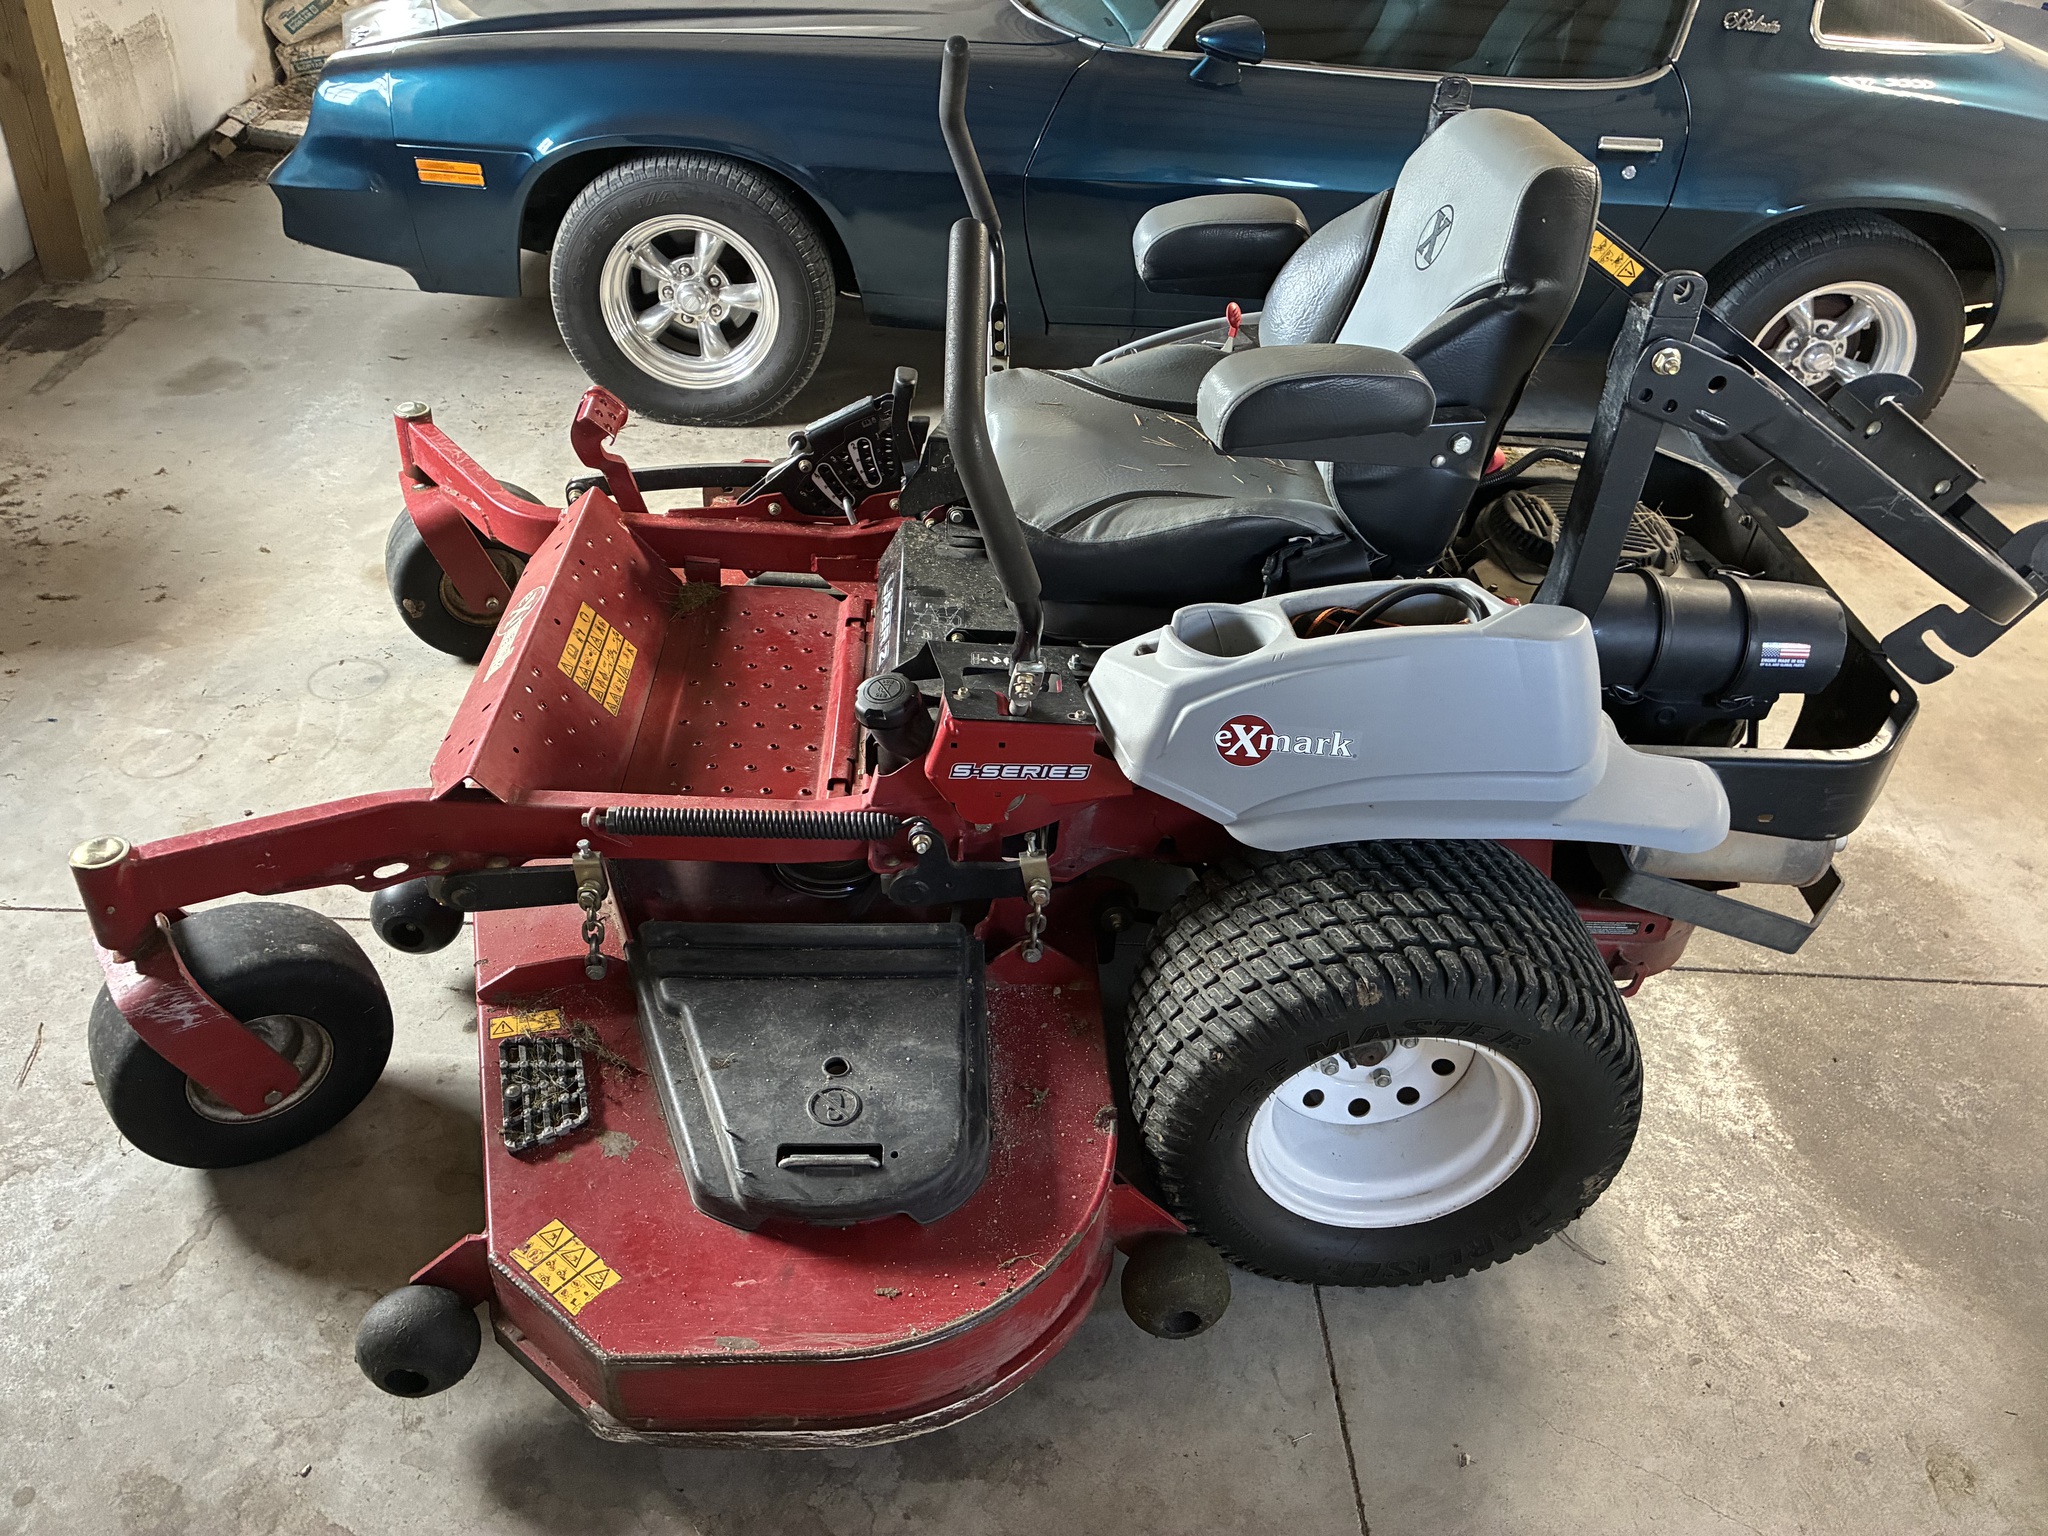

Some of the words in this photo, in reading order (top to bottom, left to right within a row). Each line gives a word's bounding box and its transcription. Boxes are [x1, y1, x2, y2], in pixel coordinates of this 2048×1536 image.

[879, 572, 895, 645] LAZER
[1214, 723, 1354, 760] eXmark
[951, 764, 1089, 779] S-SERIES
[1304, 1018, 1533, 1062] MASTER
